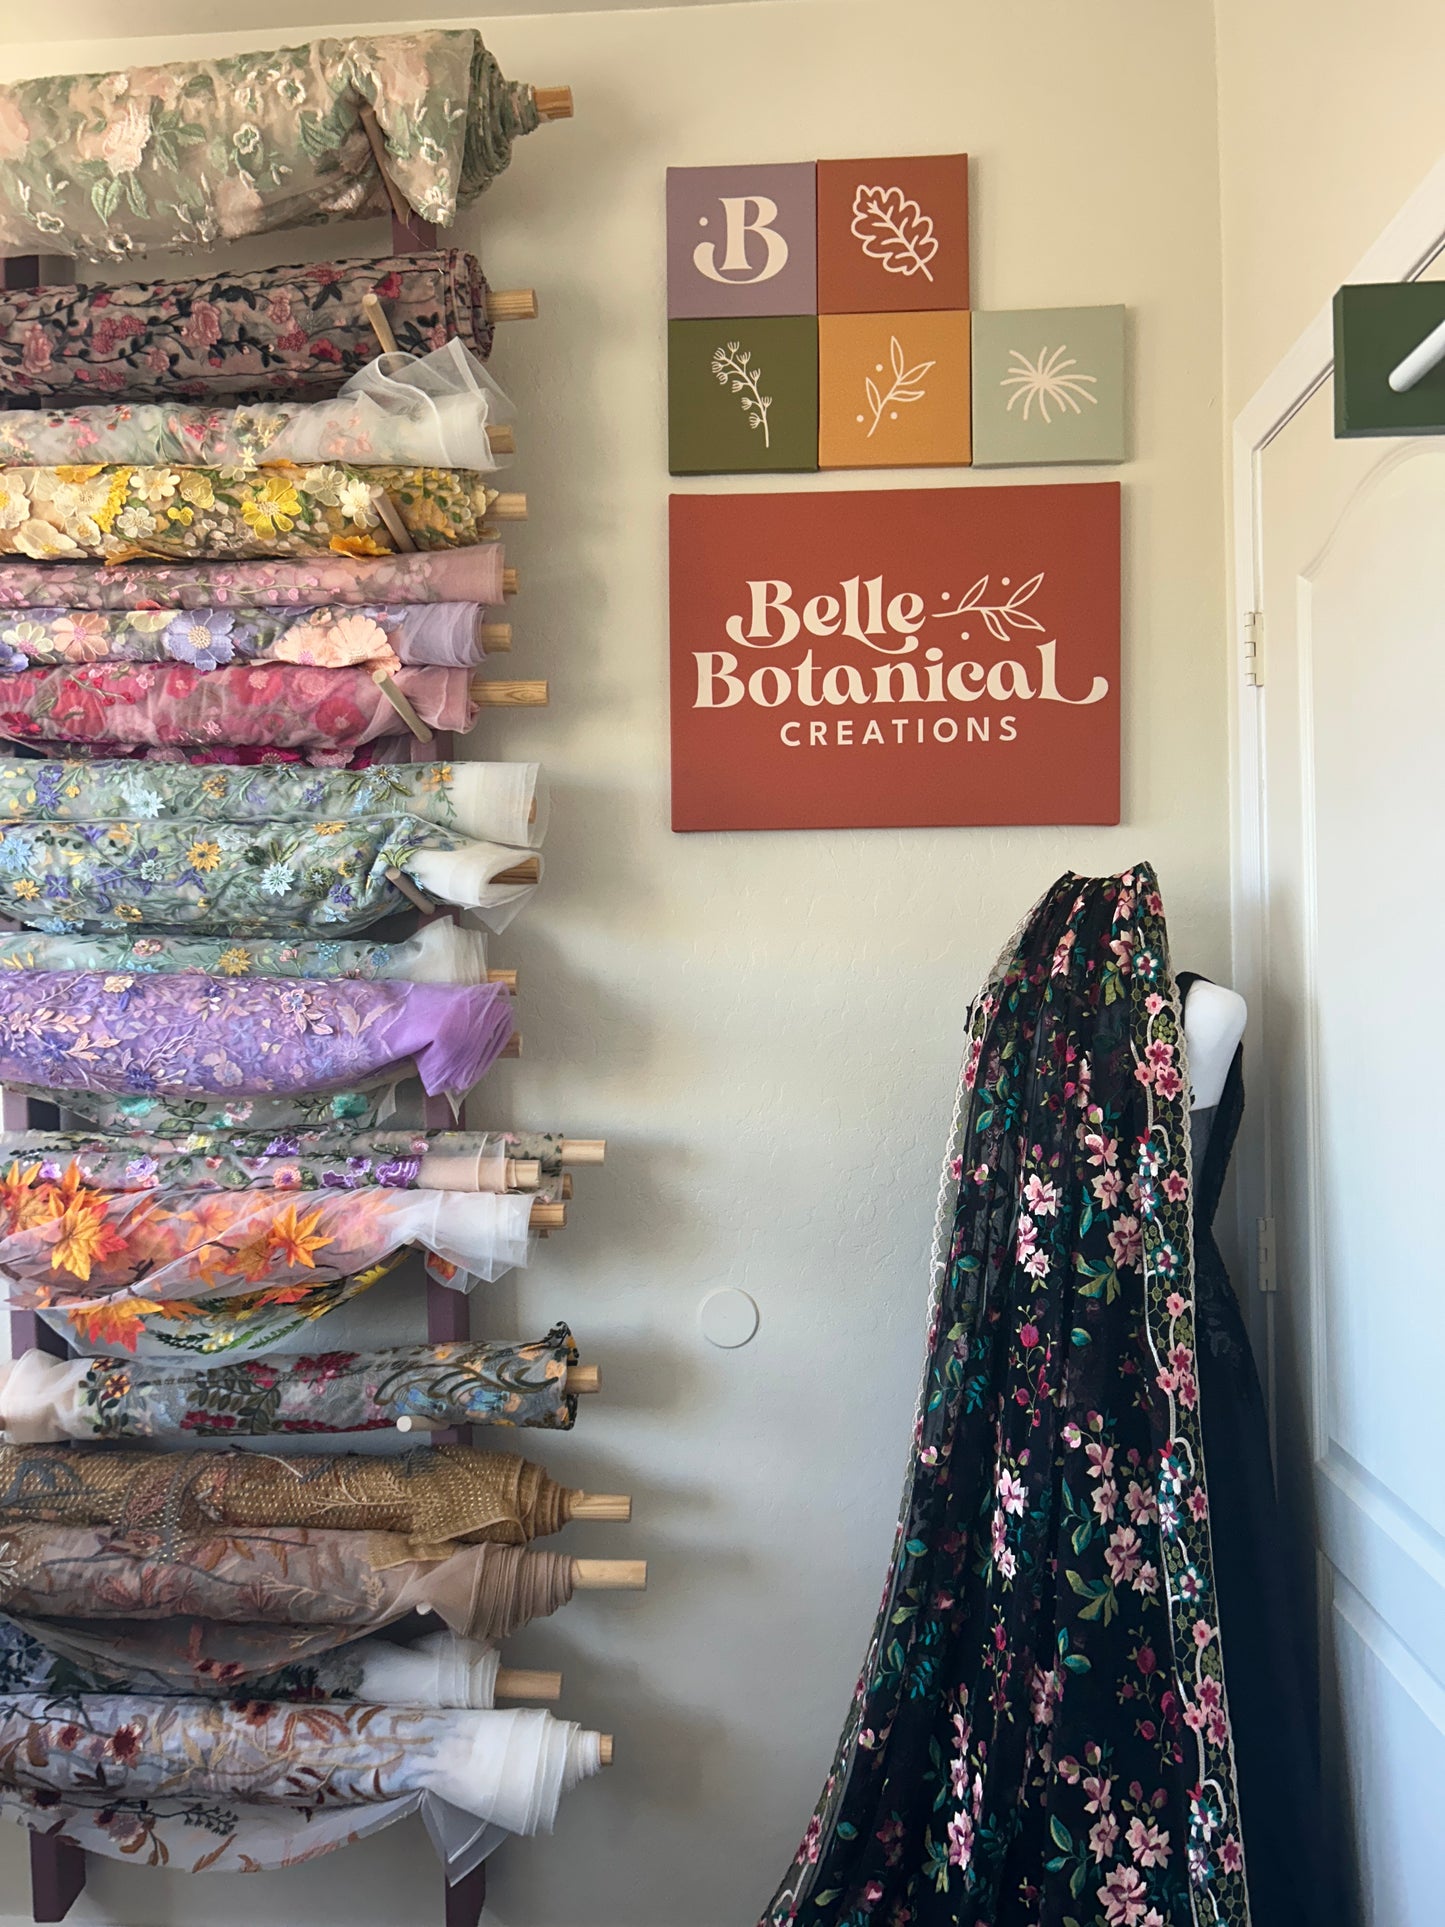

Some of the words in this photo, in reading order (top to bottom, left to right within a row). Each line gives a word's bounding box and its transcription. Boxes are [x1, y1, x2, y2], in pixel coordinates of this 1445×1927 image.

[693, 195, 789, 285] B
[725, 574, 926, 656] Belle
[780, 715, 1018, 747] CREATIONS
